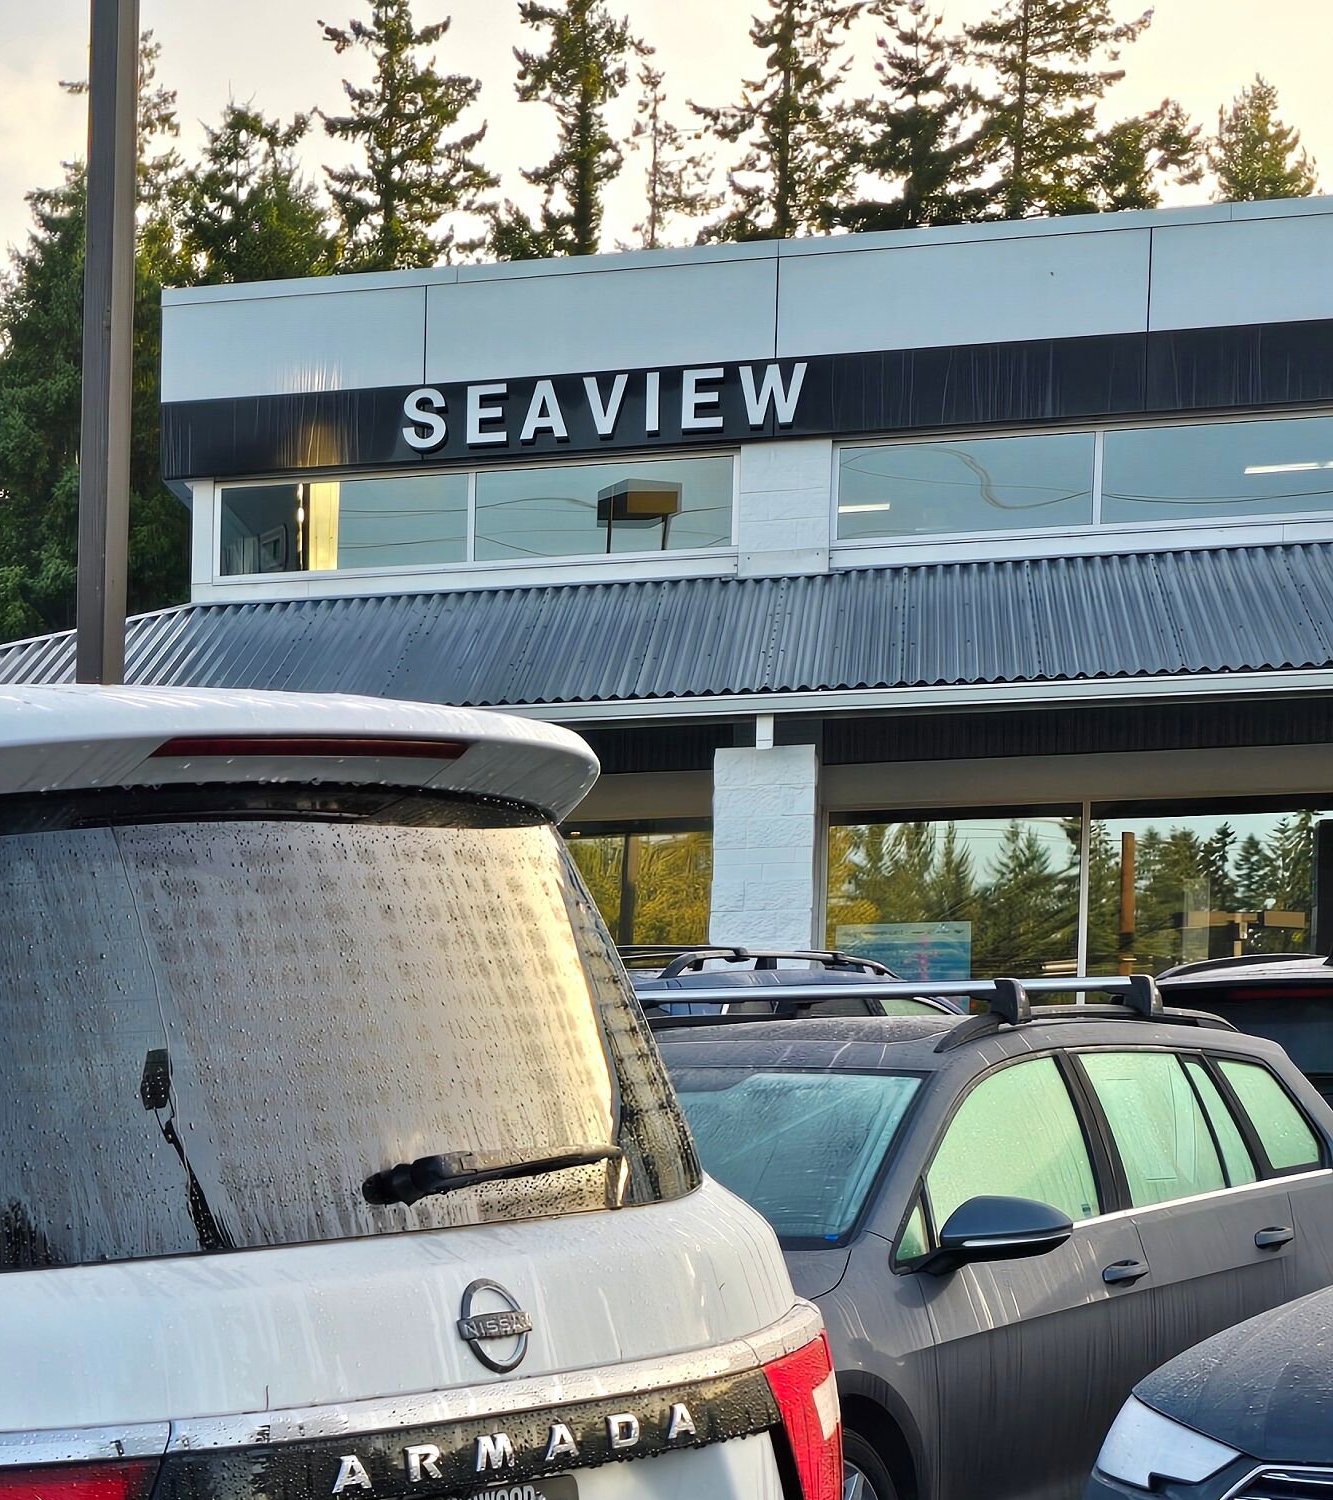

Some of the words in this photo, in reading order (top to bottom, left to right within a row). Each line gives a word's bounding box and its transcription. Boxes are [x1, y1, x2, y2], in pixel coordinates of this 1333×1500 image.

[401, 362, 808, 452] SEAVIEW
[463, 1312, 533, 1337] NISSAN
[332, 1402, 697, 1494] ARMADA
